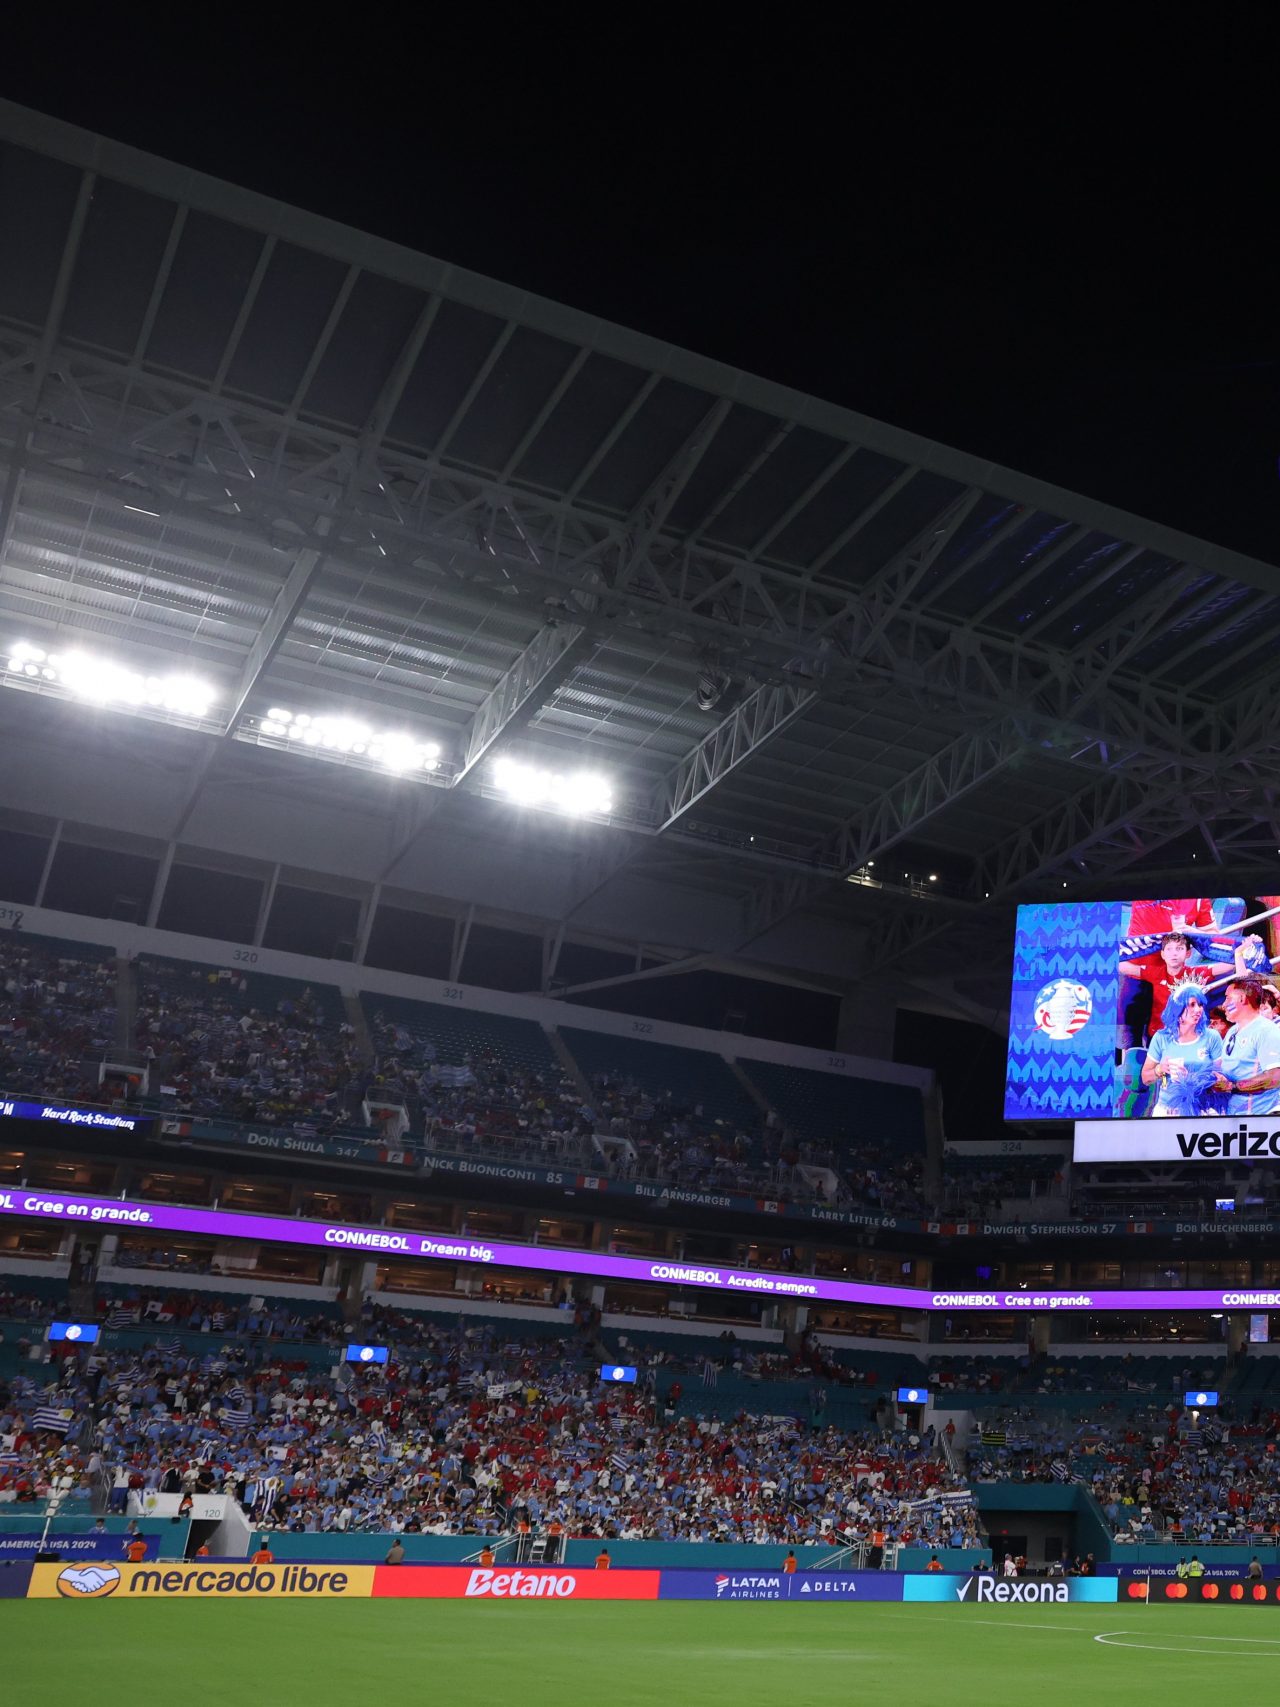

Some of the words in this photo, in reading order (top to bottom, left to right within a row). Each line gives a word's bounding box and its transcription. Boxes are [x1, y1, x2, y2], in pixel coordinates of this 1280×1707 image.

[233, 950, 259, 964] 320
[443, 987, 464, 1001] 321
[632, 1022, 653, 1034] 322
[828, 1056, 846, 1068] 323
[41, 1107, 70, 1120] Hard
[69, 1111, 94, 1125] Rock
[93, 1114, 135, 1131] Stadium
[247, 1132, 280, 1149] DON
[283, 1136, 325, 1155] SHULA
[336, 1147, 360, 1159] 347
[1002, 1142, 1022, 1152] 324
[424, 1155, 454, 1171] NICK
[459, 1161, 537, 1182] BUONICONTI
[546, 1171, 563, 1184] 85
[635, 1183, 657, 1199] BILL
[660, 1187, 731, 1208] ARNSPARGER
[24, 1197, 64, 1214] Cree
[66, 1204, 88, 1216] en
[90, 1206, 153, 1223] grande.
[811, 1207, 845, 1223] LARRY
[849, 1212, 880, 1227] LITTLE
[882, 1216, 897, 1229] 66
[983, 1224, 1027, 1236] DWIGHT
[1030, 1223, 1098, 1236] STEPHENSON
[1101, 1222, 1117, 1235] 57
[1175, 1223, 1198, 1233] BOB
[1200, 1221, 1274, 1233] KUECHENBERG
[420, 1240, 466, 1257] Dream
[469, 1244, 495, 1262] big.
[727, 1275, 775, 1291] Acredite
[775, 1281, 818, 1296] sempre.
[1004, 1294, 1031, 1307] Cree
[1033, 1297, 1047, 1307] en
[1049, 1295, 1093, 1308] grande.
[204, 1509, 221, 1518] 120
[50, 1540, 70, 1550] USA
[72, 1540, 97, 1550] 2024
[129, 1566, 276, 1592] mercado
[280, 1566, 348, 1592] libre
[465, 1569, 576, 1597] Betano
[731, 1577, 780, 1588] LATAM
[814, 1581, 856, 1593] DELTA
[977, 1575, 1069, 1603] Rexona
[731, 1590, 780, 1599] AIRLINES
